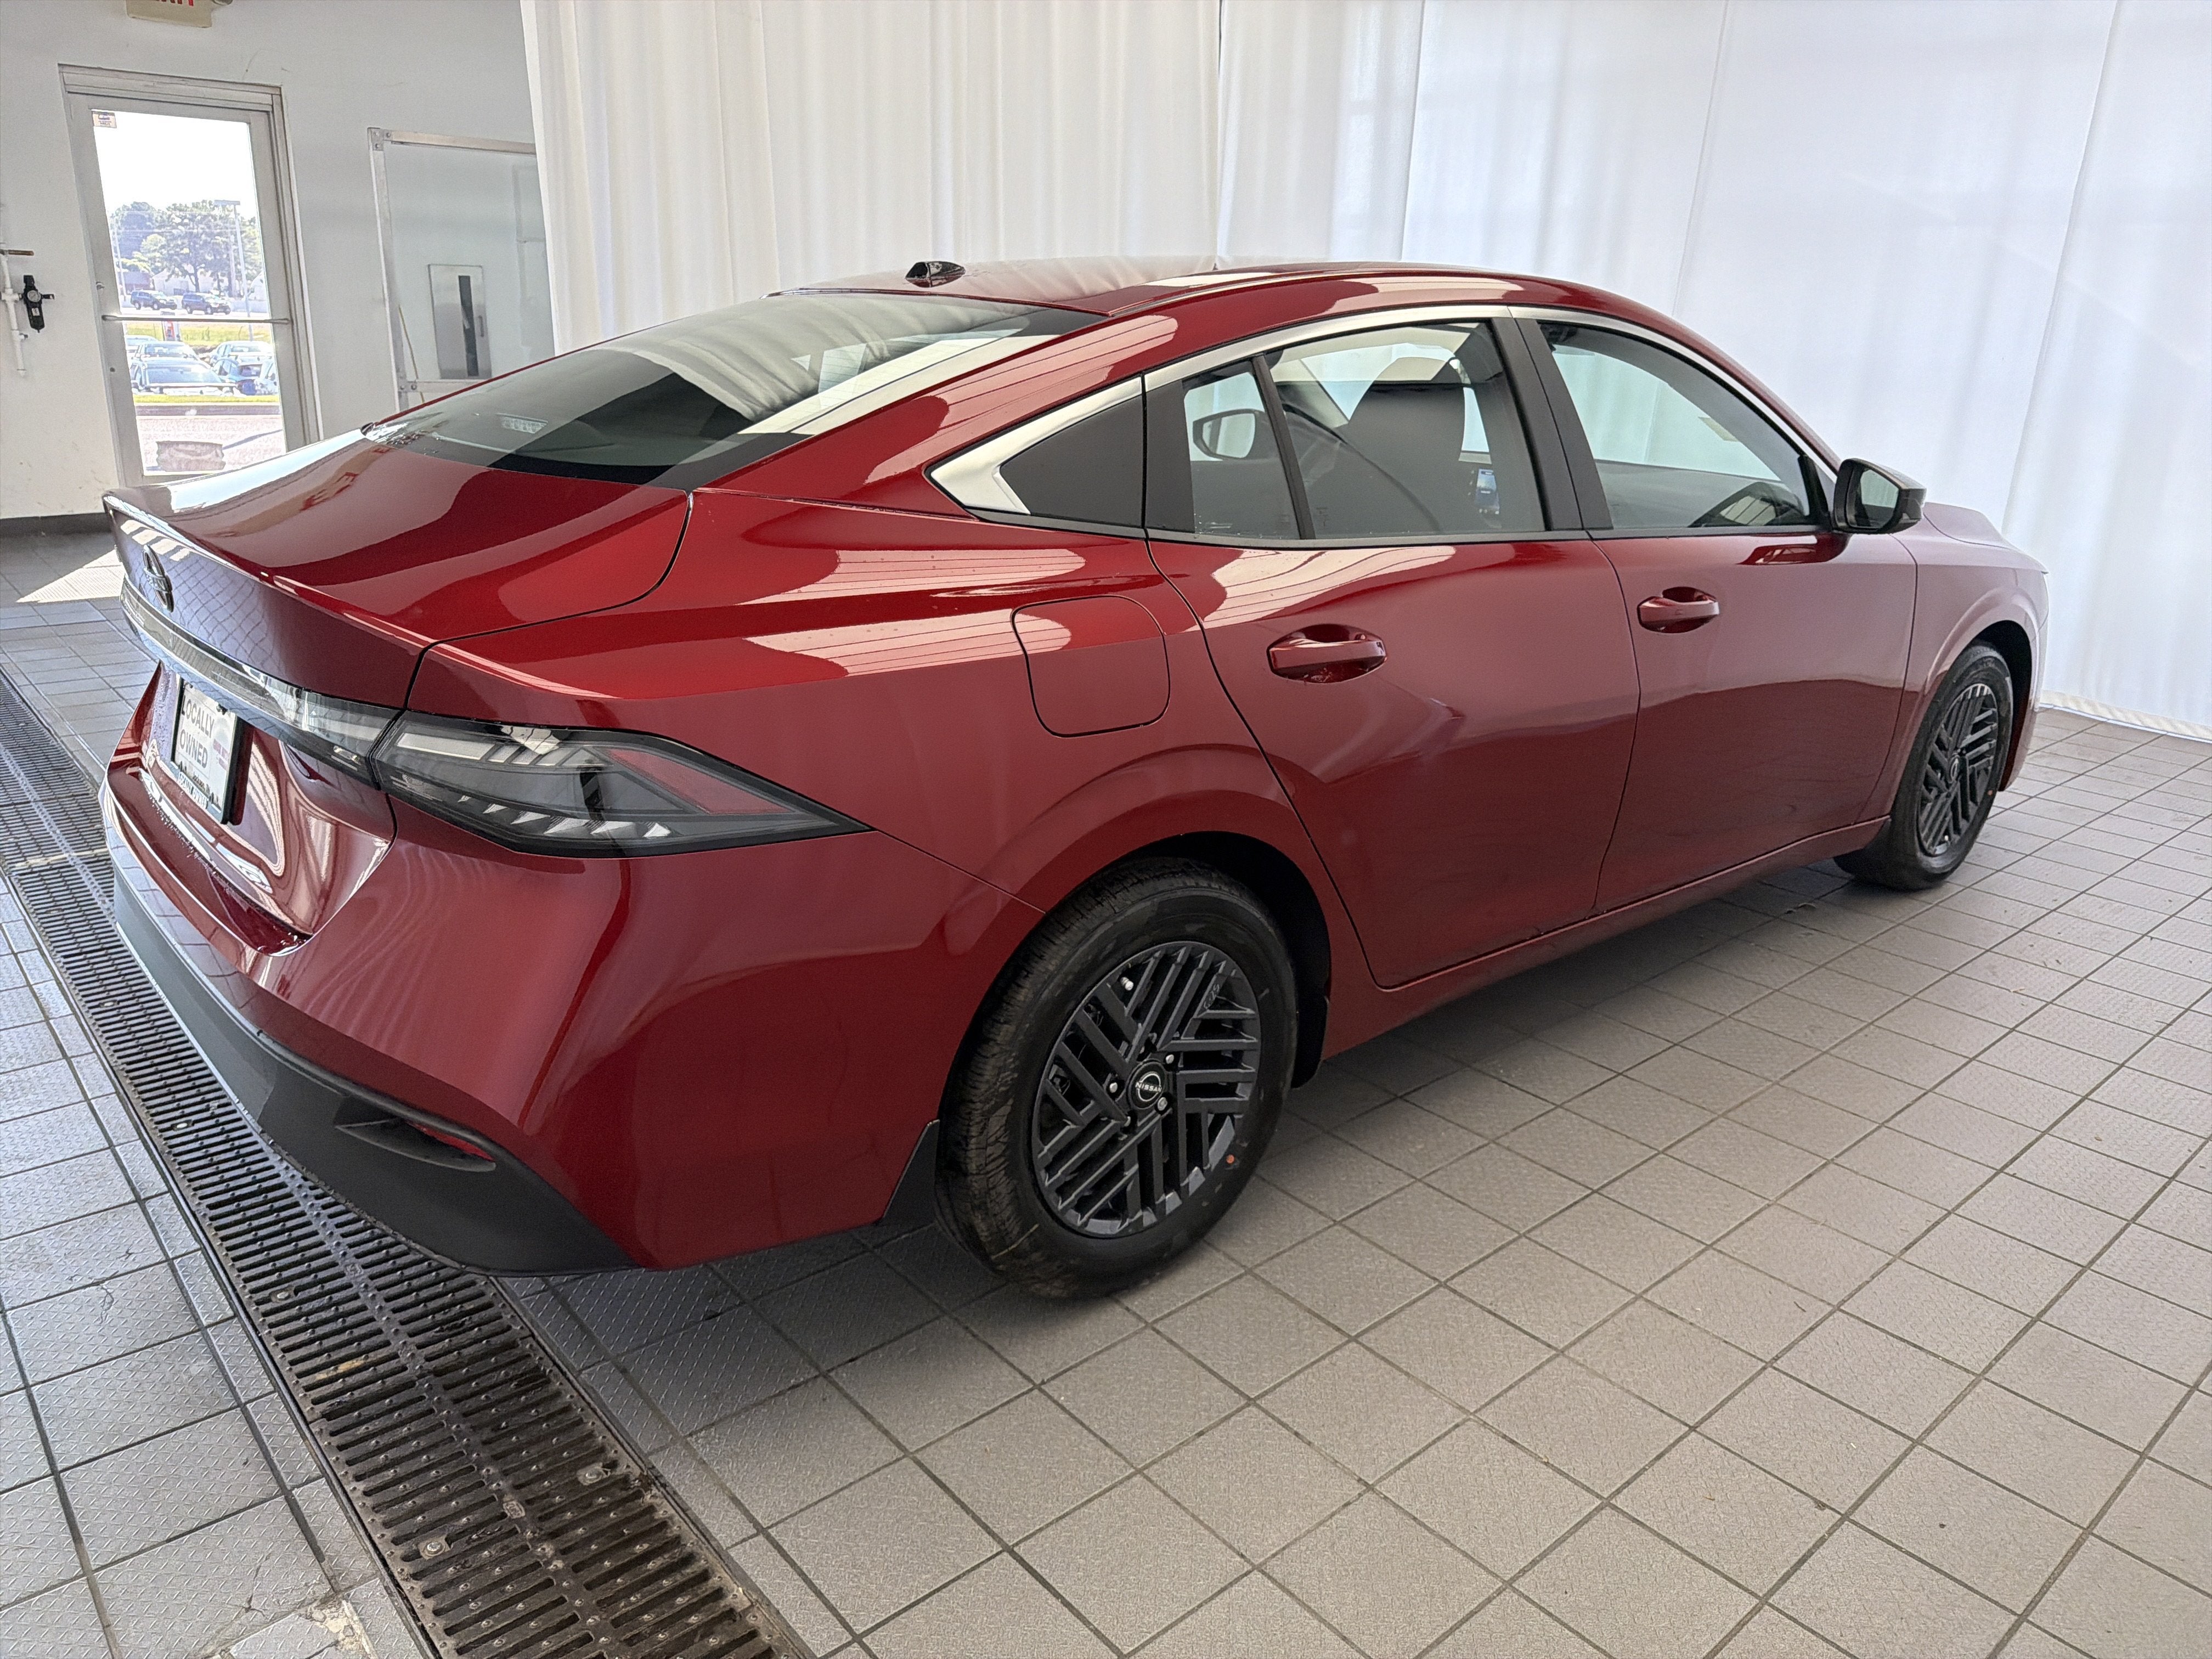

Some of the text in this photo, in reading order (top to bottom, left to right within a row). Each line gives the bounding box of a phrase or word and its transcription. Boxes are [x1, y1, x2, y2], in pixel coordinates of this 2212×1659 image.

[181, 695, 215, 738] LOCALLY
[180, 729, 208, 769] OWNED
[1135, 1082, 1162, 1092] NISSAN
